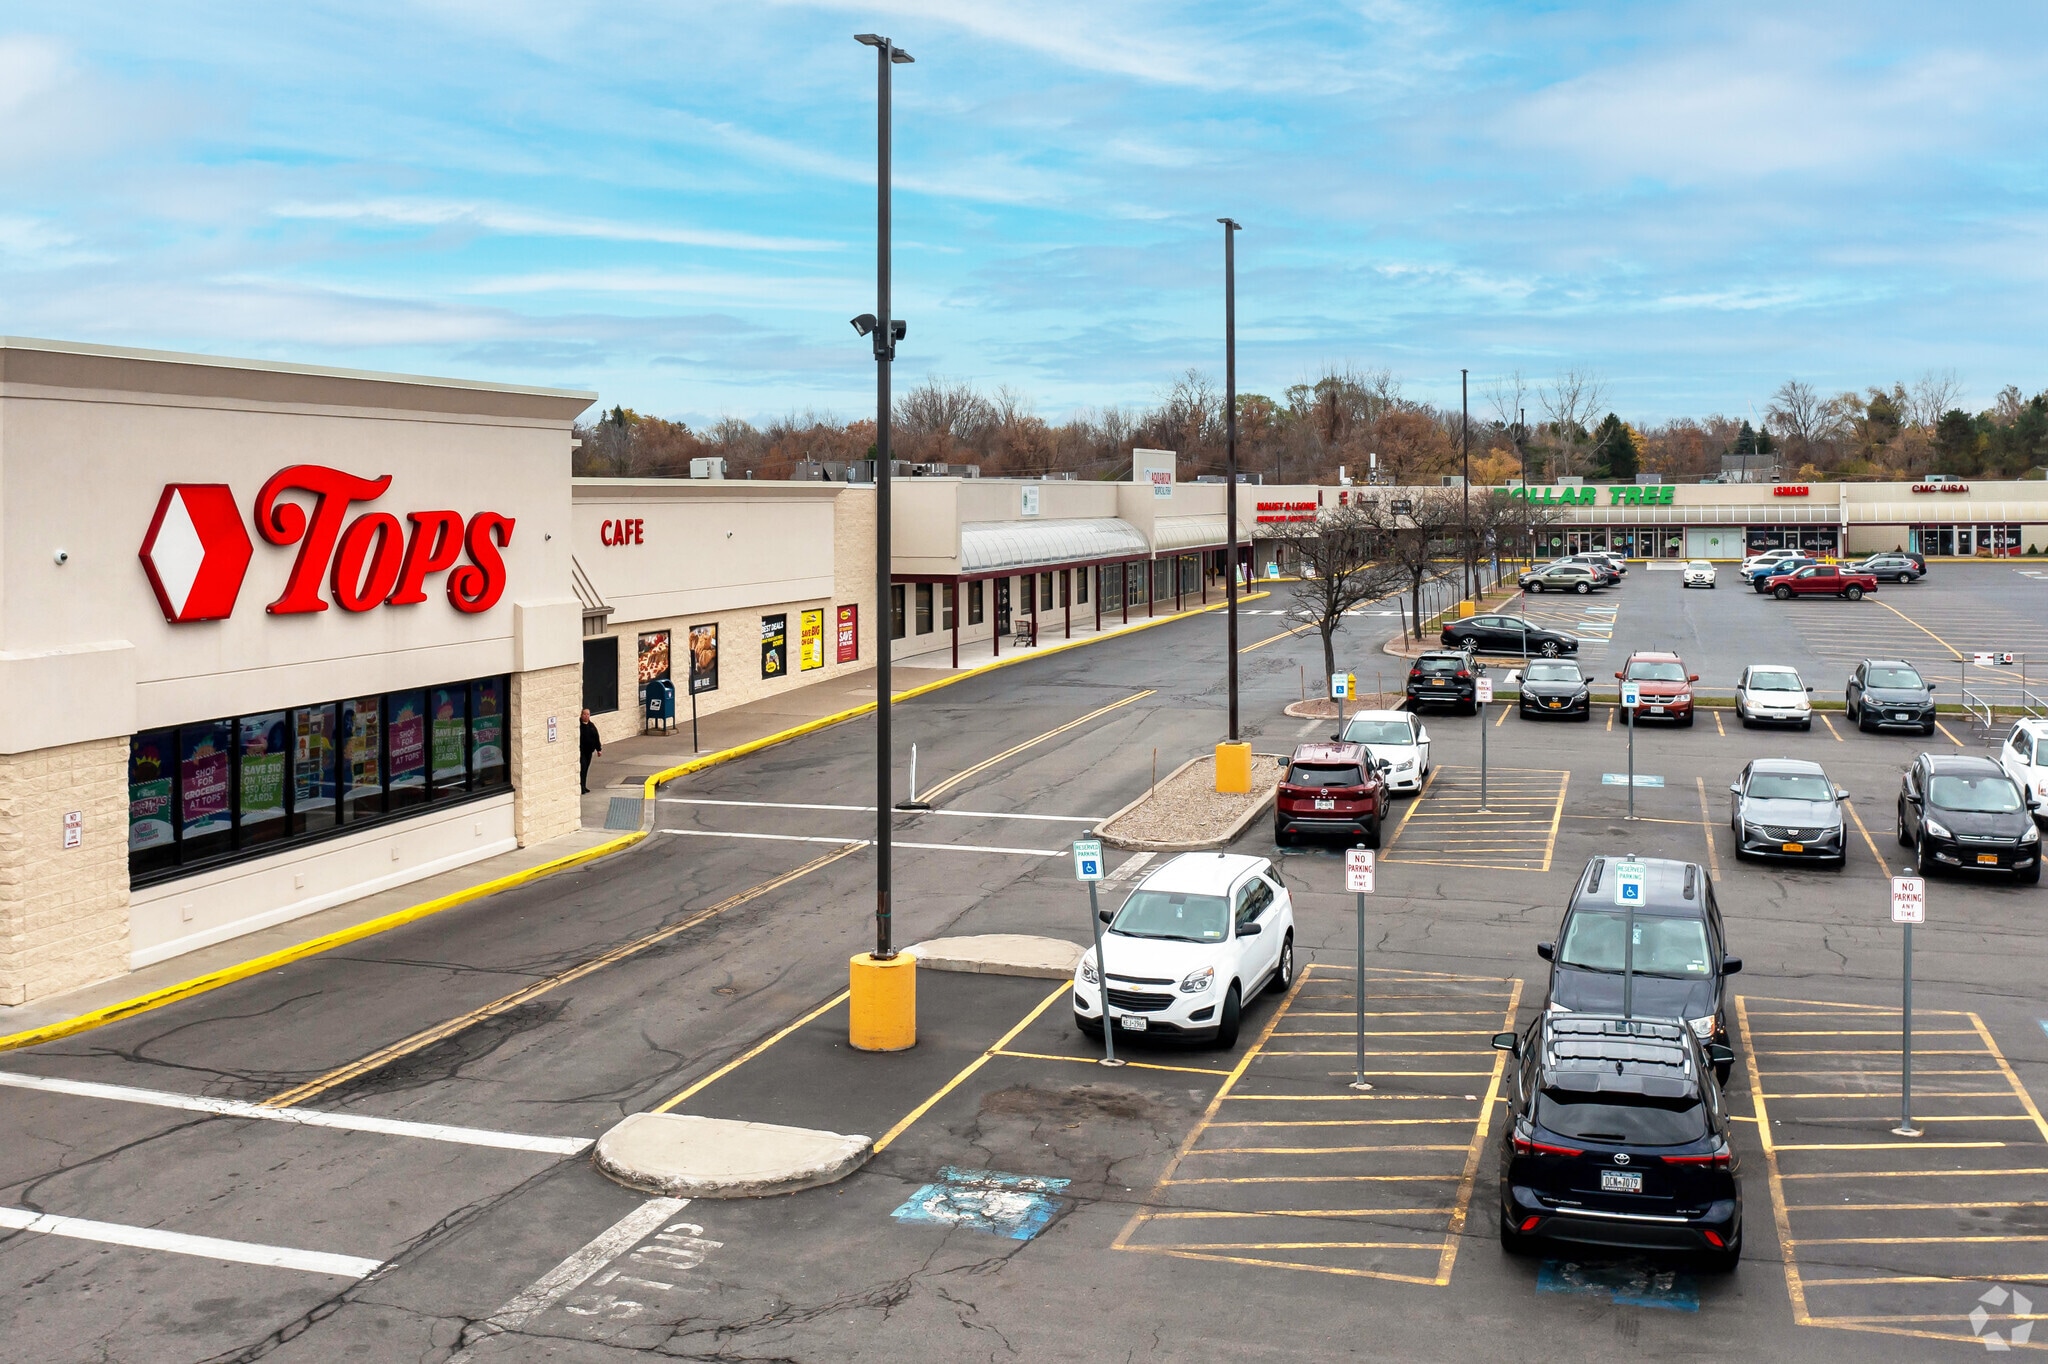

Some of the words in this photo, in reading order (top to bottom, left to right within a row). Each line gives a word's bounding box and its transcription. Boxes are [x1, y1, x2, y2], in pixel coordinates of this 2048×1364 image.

[1912, 484, 1937, 493] CMC
[1940, 484, 1969, 493] (USA)
[1608, 486, 1675, 505] TREE
[601, 518, 644, 547] CAFE
[811, 624, 820, 636] BIG
[399, 728, 415, 740] SHOP
[401, 737, 414, 748] FOR
[395, 756, 405, 765] AT
[195, 766, 216, 779] SHOP
[244, 765, 266, 776] SAVE
[268, 763, 282, 773] $10
[197, 775, 214, 787] FOR
[244, 777, 256, 785] ON
[258, 774, 281, 784] THESE
[184, 782, 226, 801] GROCERIES
[261, 783, 277, 792] GIFT
[249, 791, 274, 803] CARDS
[189, 799, 200, 810] AT
[133, 805, 159, 818] BONUS
[1354, 855, 1366, 863] NO
[1348, 864, 1373, 873] PARKING
[1902, 883, 1914, 891] NO
[1894, 893, 1922, 902] PARKING
[565, 1222, 724, 1319] STOP
